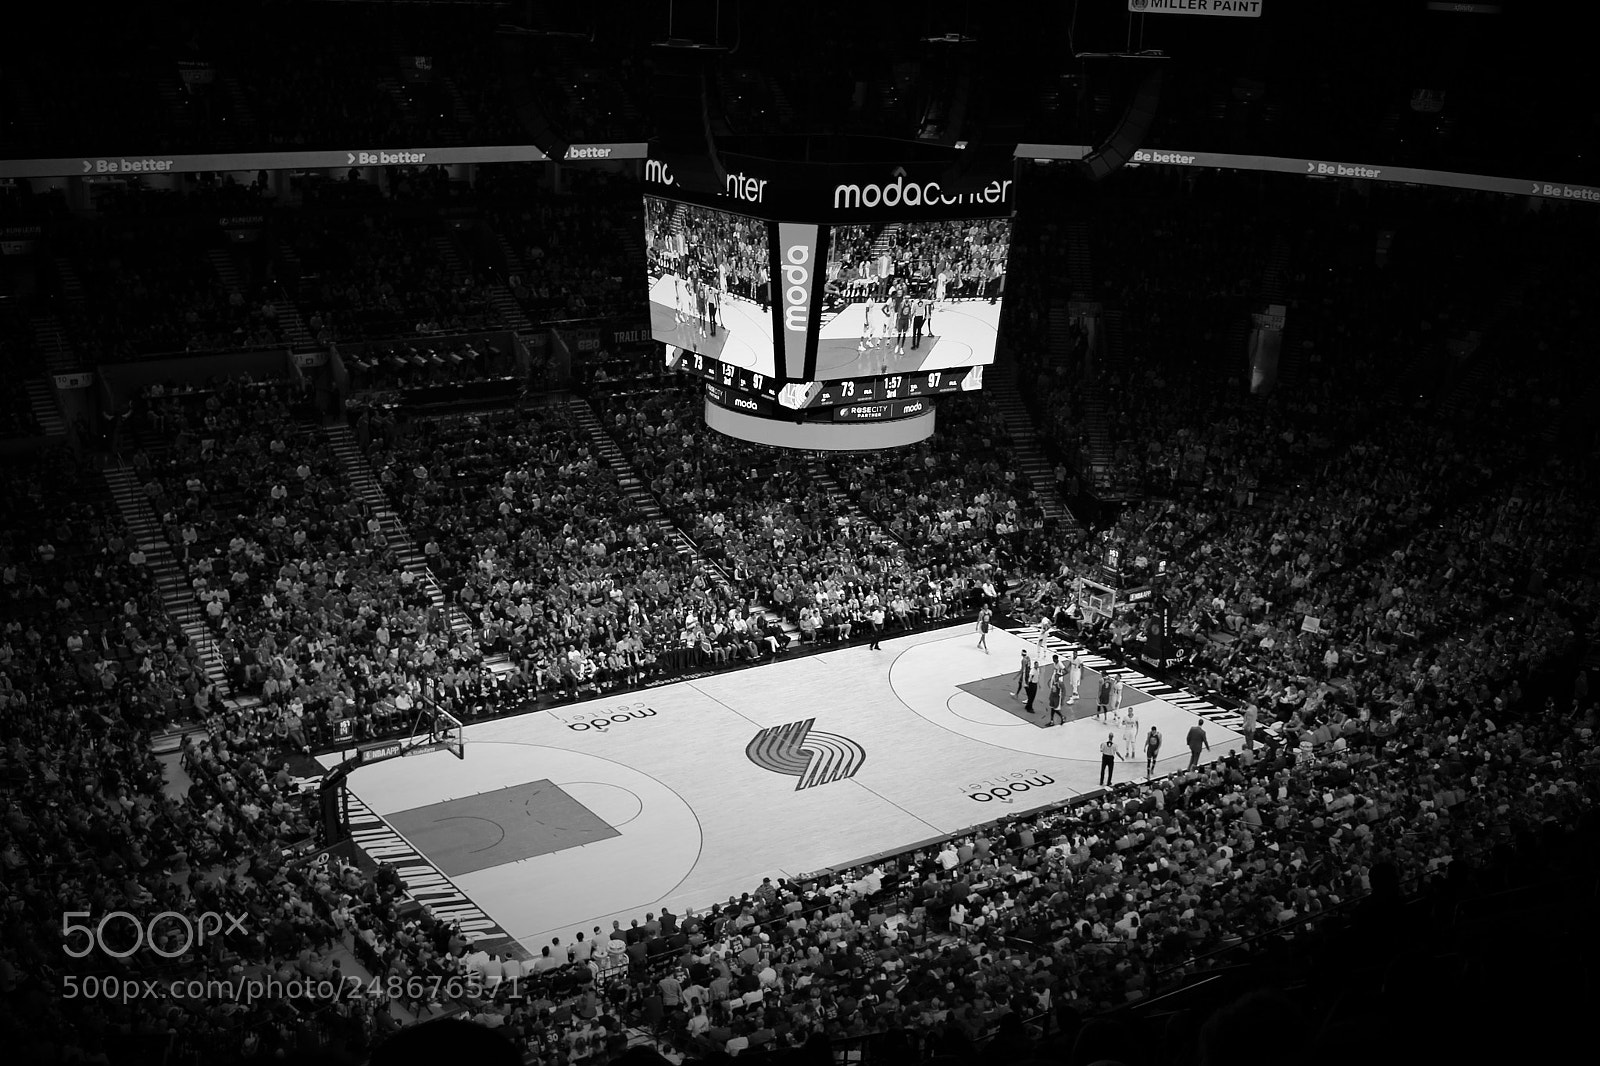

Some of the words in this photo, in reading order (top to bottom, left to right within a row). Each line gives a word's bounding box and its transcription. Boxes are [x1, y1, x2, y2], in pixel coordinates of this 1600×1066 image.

[1151, 0, 1207, 9] MILLER
[1213, 0, 1259, 12] PAINT
[359, 153, 378, 164] Be
[380, 151, 425, 164] better
[570, 146, 611, 158] better
[1133, 150, 1151, 162] Be
[1153, 151, 1196, 165] better
[96, 160, 118, 173] Be
[121, 158, 173, 172] better
[1317, 163, 1336, 175] Be
[1337, 165, 1381, 179] better
[1542, 184, 1561, 196] Be
[1564, 185, 1600, 201] bette
[781, 245, 809, 331] moda
[693, 354, 703, 371] 73
[753, 373, 764, 390] 97
[884, 376, 902, 390] 1:57
[928, 372, 941, 388] 97
[841, 381, 855, 397] 73
[735, 398, 758, 410] moda
[903, 400, 922, 413] moda
[568, 708, 657, 731] moda
[372, 749, 386, 759] NBA
[386, 746, 400, 757] APP
[958, 768, 1038, 793] center
[968, 774, 1055, 802] moda
[546, 1033, 558, 1043] 30
